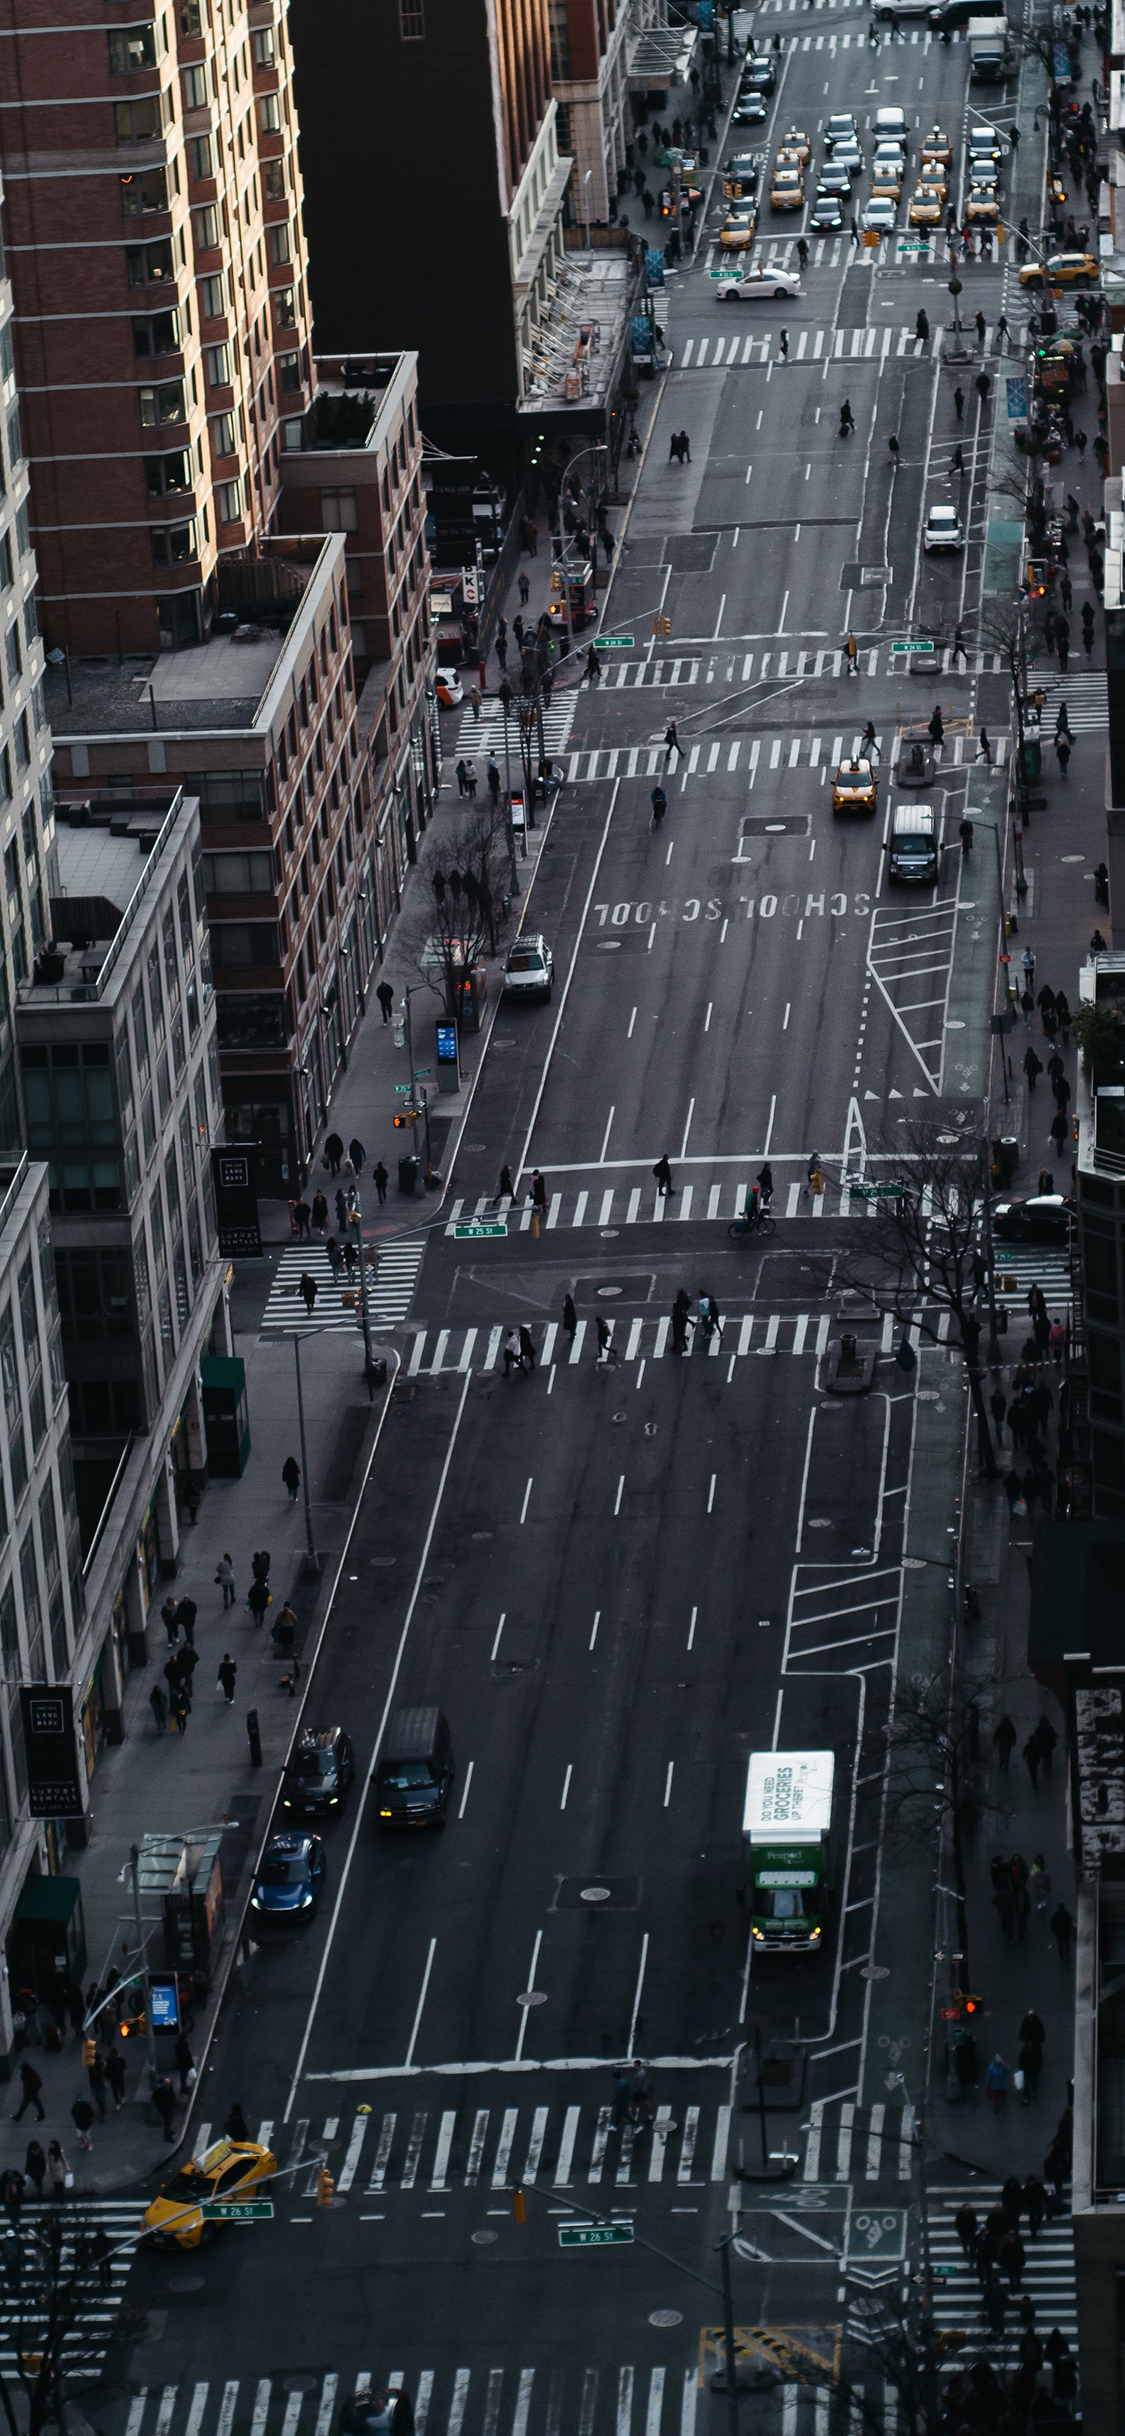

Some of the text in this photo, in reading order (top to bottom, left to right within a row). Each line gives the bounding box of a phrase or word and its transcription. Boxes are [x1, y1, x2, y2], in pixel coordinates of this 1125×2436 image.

[485, 1227, 493, 1235] St
[221, 1232, 258, 1240] LUXURY
[31, 1787, 76, 1795] LUXURY
[773, 1766, 793, 1821] GROCERIES
[32, 1794, 77, 1803] RENTALS
[761, 1777, 775, 1821] DO YOU NEED
[791, 1785, 803, 1821] UP THERE?
[767, 1851, 802, 1861] Peapod
[220, 2207, 253, 2216] W 26 St
[579, 2232, 613, 2242] W 26 St
